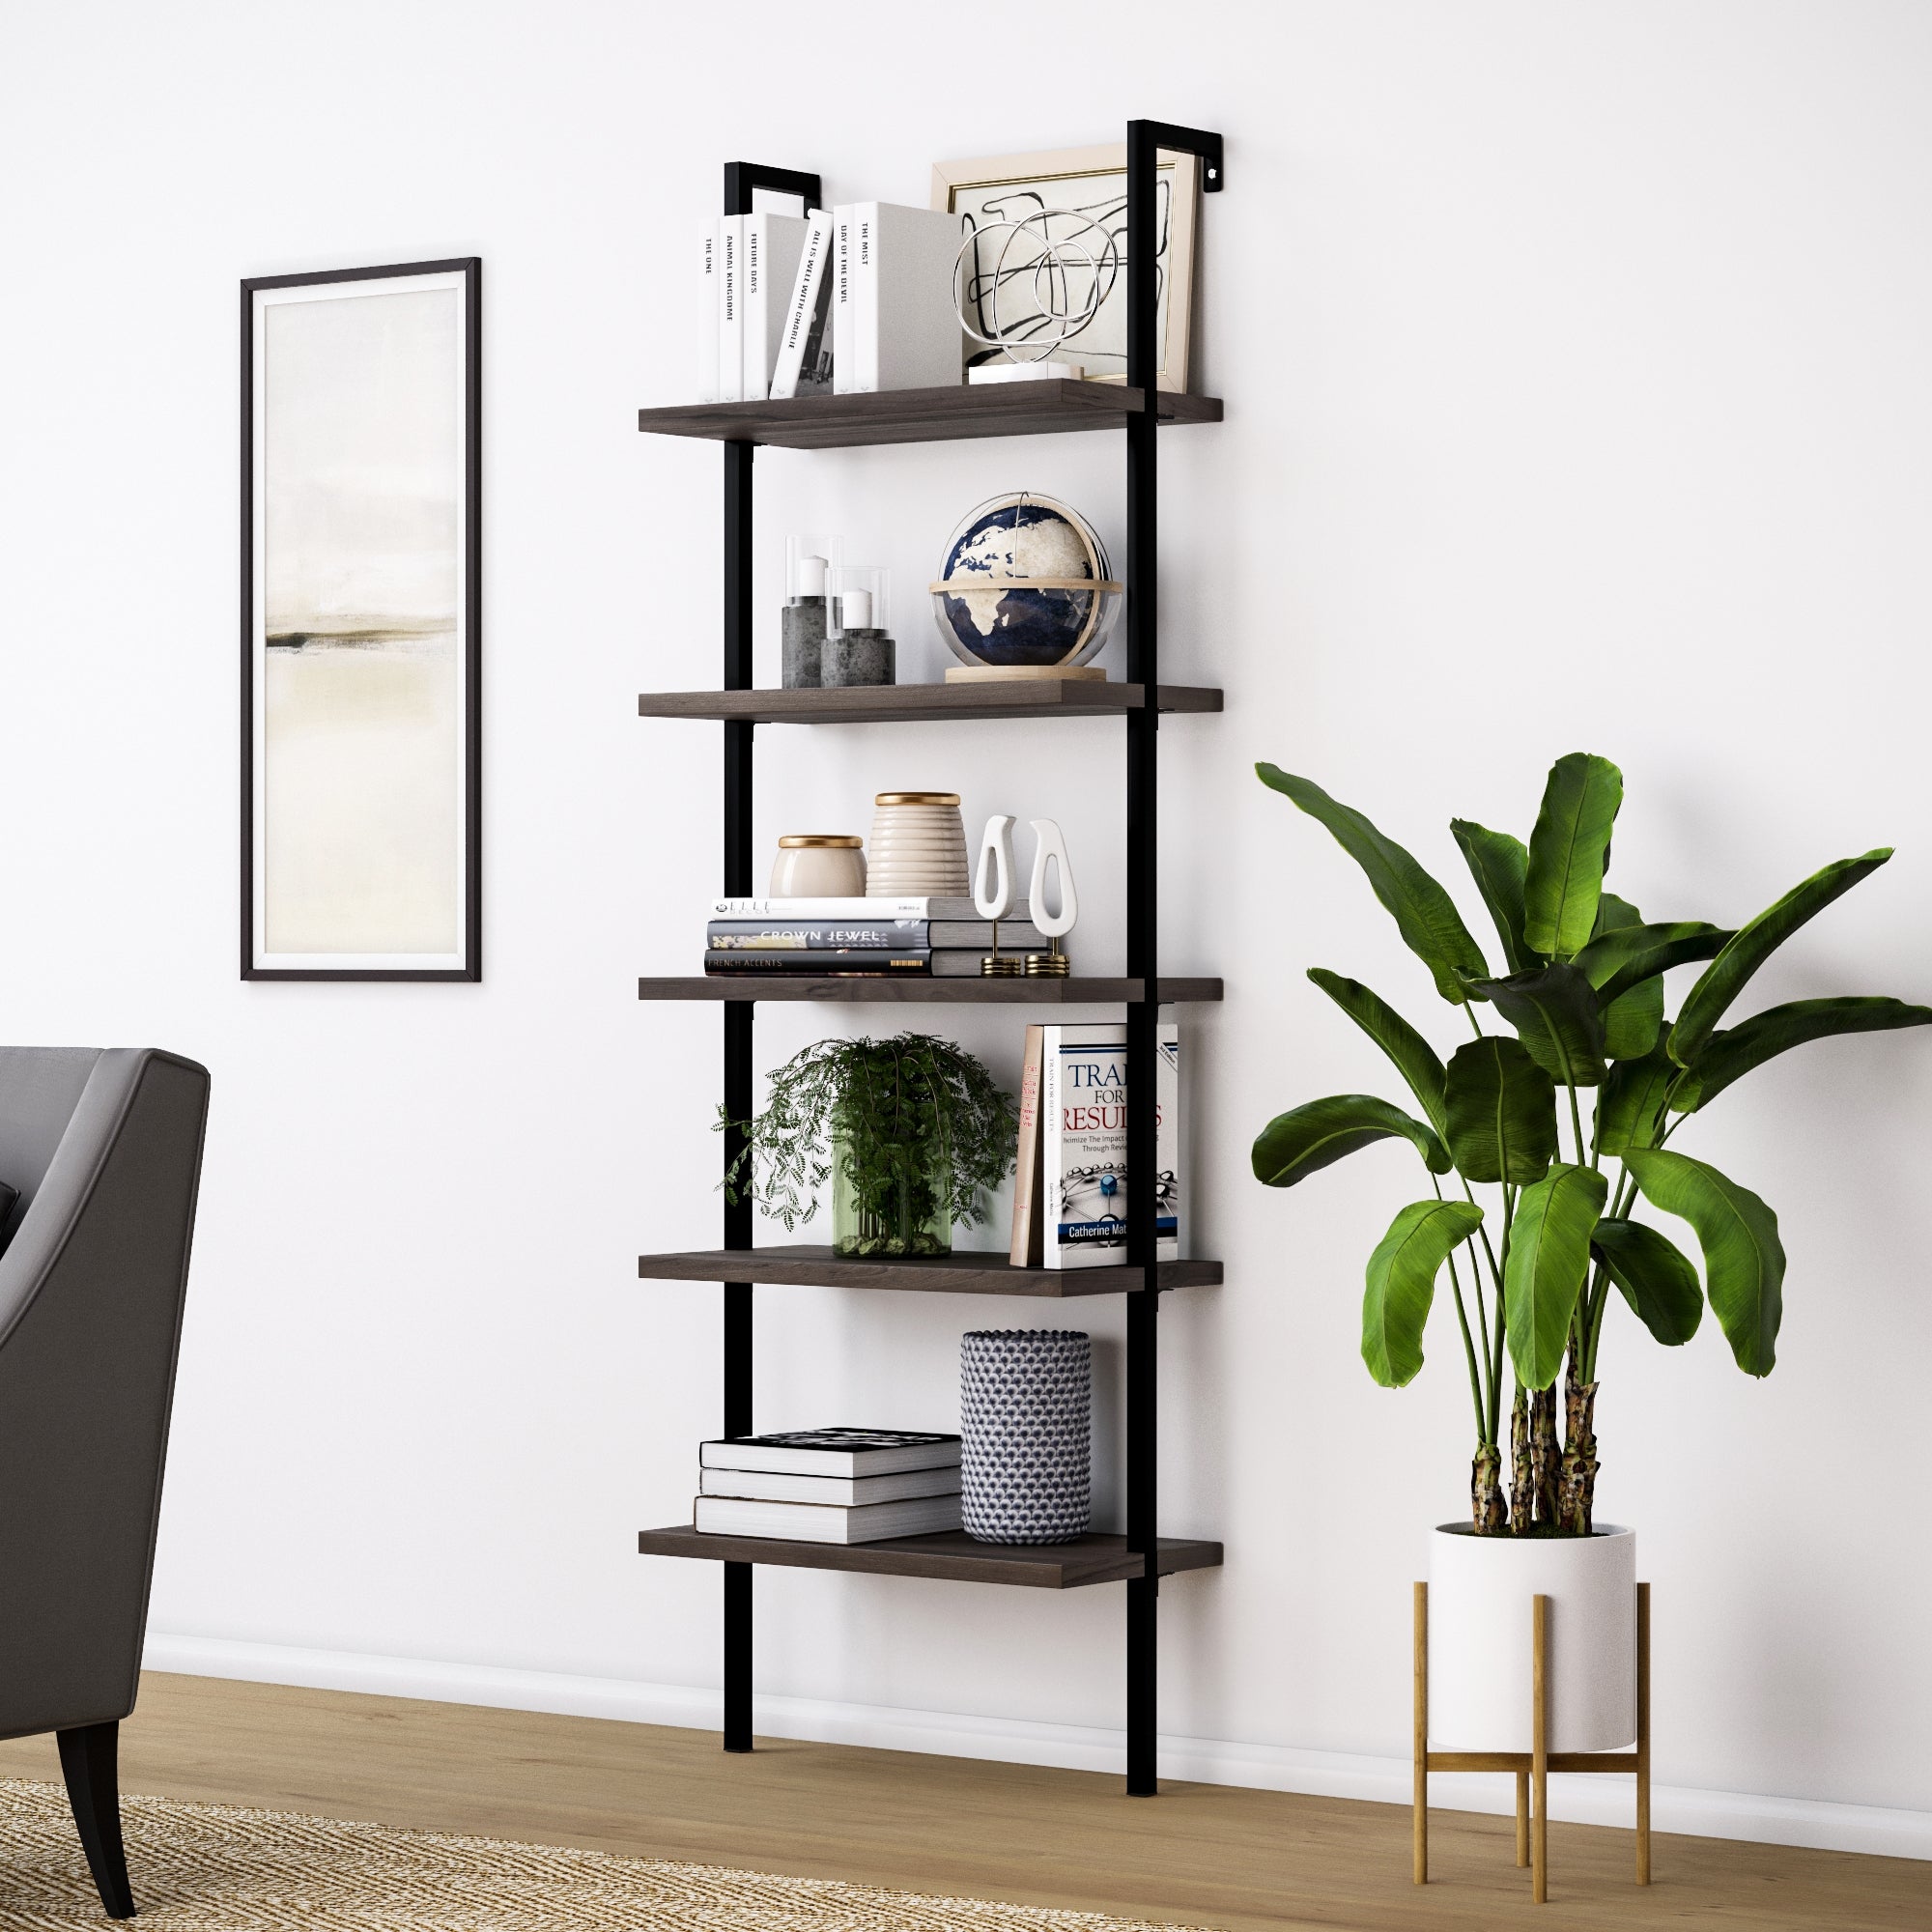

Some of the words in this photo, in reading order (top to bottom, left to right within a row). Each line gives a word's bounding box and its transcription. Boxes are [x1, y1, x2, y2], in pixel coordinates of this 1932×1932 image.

[812, 230, 821, 245] ALL
[810, 247, 817, 258] IS
[840, 244, 847, 256] OF
[803, 259, 814, 283] WELL
[797, 284, 809, 310] WITH
[787, 311, 803, 350] CHARLIE
[760, 930, 821, 941] CROWN
[827, 930, 880, 941] JEWEL
[708, 958, 741, 967] FRENCH
[743, 958, 782, 967] ACCENTS
[1067, 1064, 1128, 1088] TRAI
[1094, 1090, 1125, 1104] FOR
[1102, 1135, 1124, 1144] Impact
[1068, 1224, 1110, 1237] Catherine
